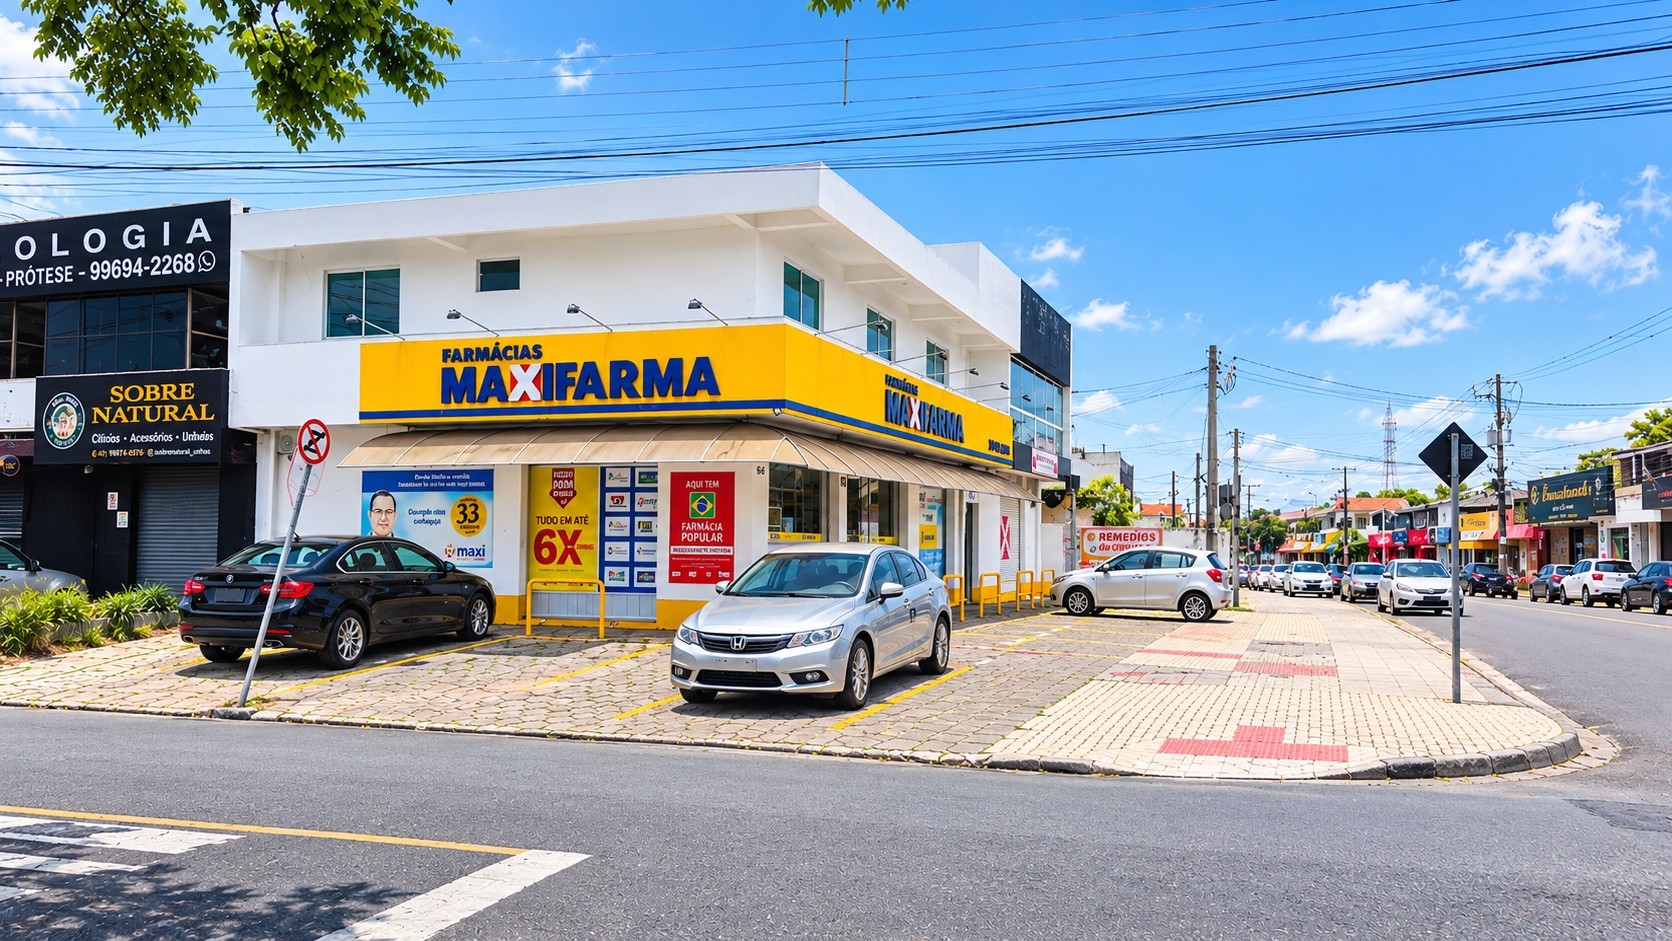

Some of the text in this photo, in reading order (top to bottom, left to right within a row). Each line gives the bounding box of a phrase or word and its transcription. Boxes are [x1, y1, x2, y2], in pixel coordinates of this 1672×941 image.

[6, 264, 74, 287] PRÓTESE
[90, 252, 195, 281] 99694-2268
[442, 342, 543, 363] FARMÁCIAS
[440, 356, 721, 404] MAXIFARMA
[110, 382, 195, 403] SOBRE
[91, 403, 215, 424] NATURAL
[885, 389, 964, 443] MAXIFARMA
[685, 480, 719, 489] AQUI TEM
[456, 503, 479, 525] 33
[536, 514, 588, 525] TUDO EM ATÉ
[681, 521, 723, 531] FARMÁCIA
[533, 528, 583, 565] 6X
[681, 532, 723, 542] POPULAR
[457, 544, 485, 558] maxi
